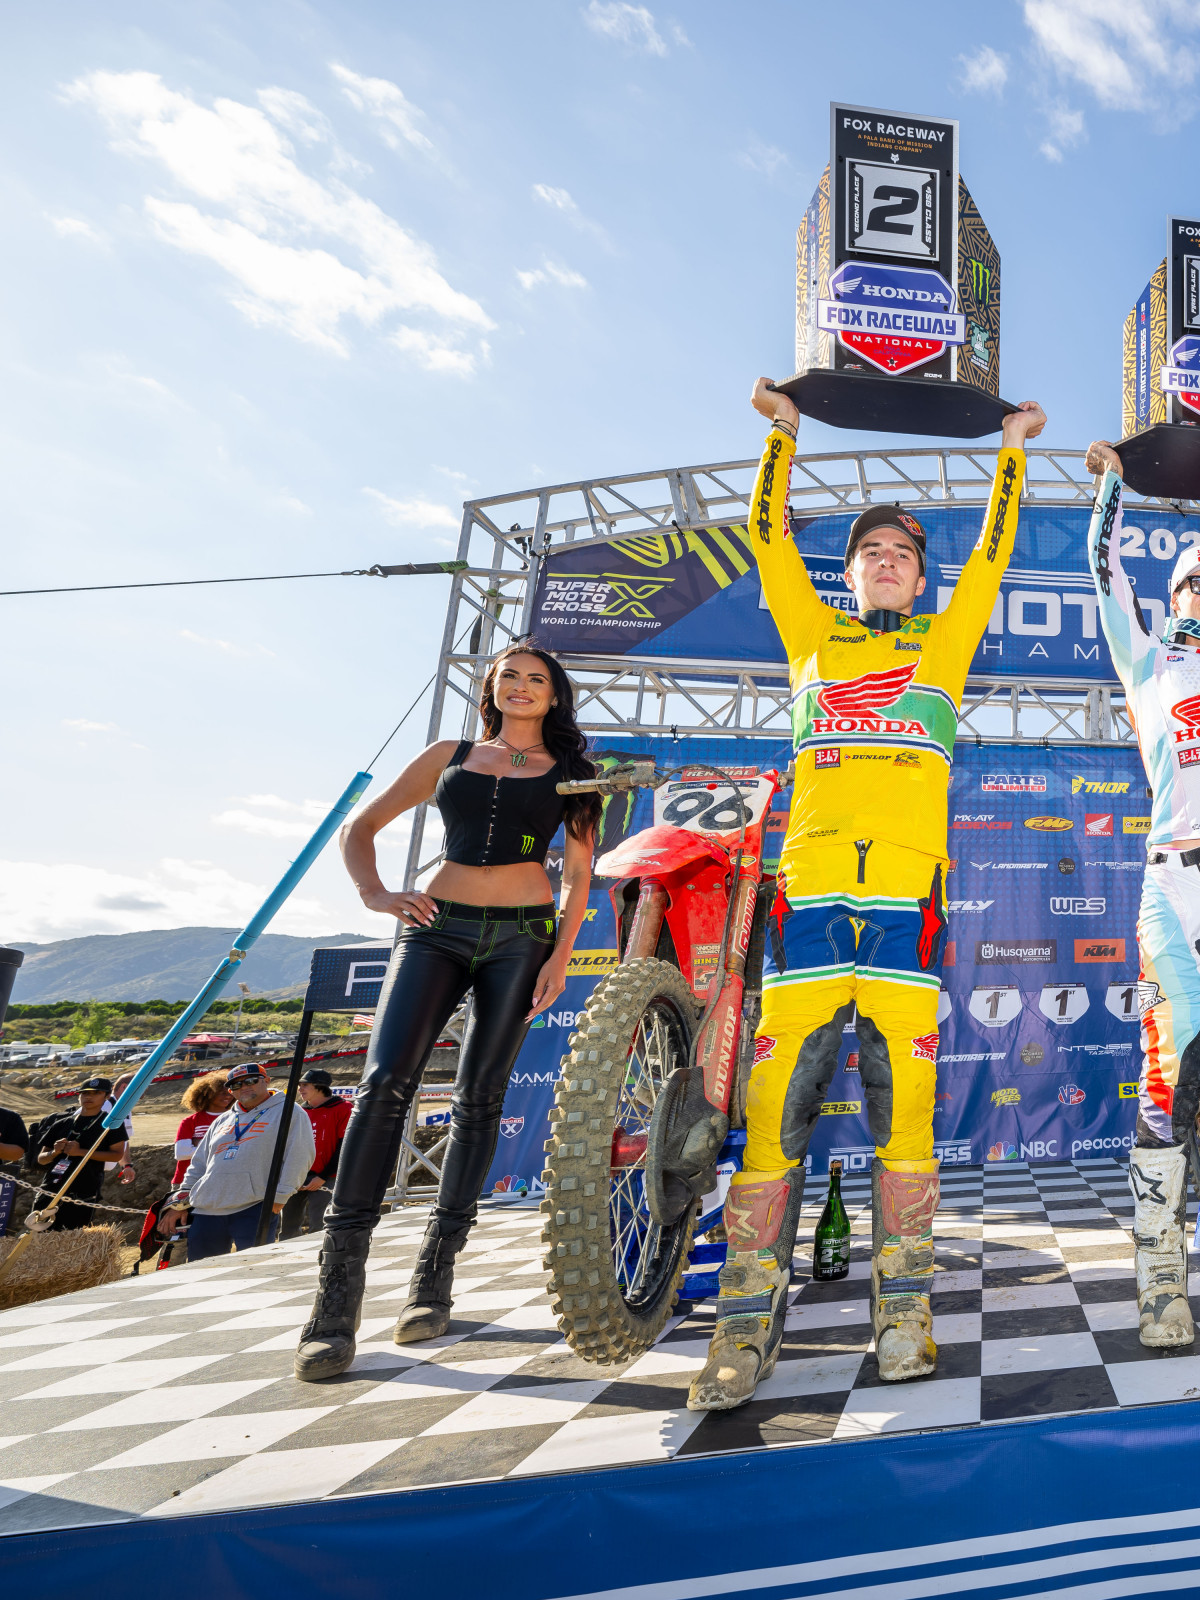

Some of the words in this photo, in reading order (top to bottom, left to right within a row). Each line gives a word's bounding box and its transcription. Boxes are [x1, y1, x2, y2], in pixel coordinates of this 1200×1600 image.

[844, 117, 871, 132] FOX
[877, 122, 946, 142] RACEWAY
[867, 141, 893, 150] INDIANS
[894, 145, 923, 154] COMPANY
[906, 140, 933, 149] MISSION
[853, 175, 861, 204] PLACE
[866, 184, 920, 236] 2
[853, 204, 861, 233] SECOND
[863, 284, 949, 304] HONDA
[827, 306, 864, 326] FOX
[866, 311, 957, 336] RACEWAY
[852, 334, 933, 350] NATIONAL
[1168, 372, 1199, 389] FOX
[987, 456, 1017, 563] alpinestars
[1094, 480, 1121, 597] alpinestars
[545, 581, 612, 594] SUPER
[546, 592, 607, 603] MOTO
[541, 602, 606, 613] CROSS
[540, 617, 577, 625] WORLD
[579, 618, 662, 629] CHAMPIONSHIP
[828, 633, 867, 645] SHOWA
[812, 719, 929, 736] HONDA
[982, 775, 1046, 785] PARTS
[982, 784, 1046, 792] UNLIMITED
[1084, 782, 1130, 794] THOR
[662, 791, 754, 831] 96
[1027, 817, 1074, 830] FMF
[1050, 897, 1106, 915] WPS
[995, 946, 1051, 957] Husqvarna
[1083, 945, 1117, 957] KTM
[693, 958, 719, 966] HINS
[713, 1005, 738, 1102] DUNLOP
[1057, 1043, 1132, 1053] INTENSE
[991, 1088, 1019, 1100] MOTO
[821, 1101, 860, 1113] ERBIS
[995, 1094, 1021, 1108] TEES
[504, 1124, 517, 1135] X
[1020, 1140, 1058, 1158] NBC
[1071, 1131, 1138, 1159] peacock
